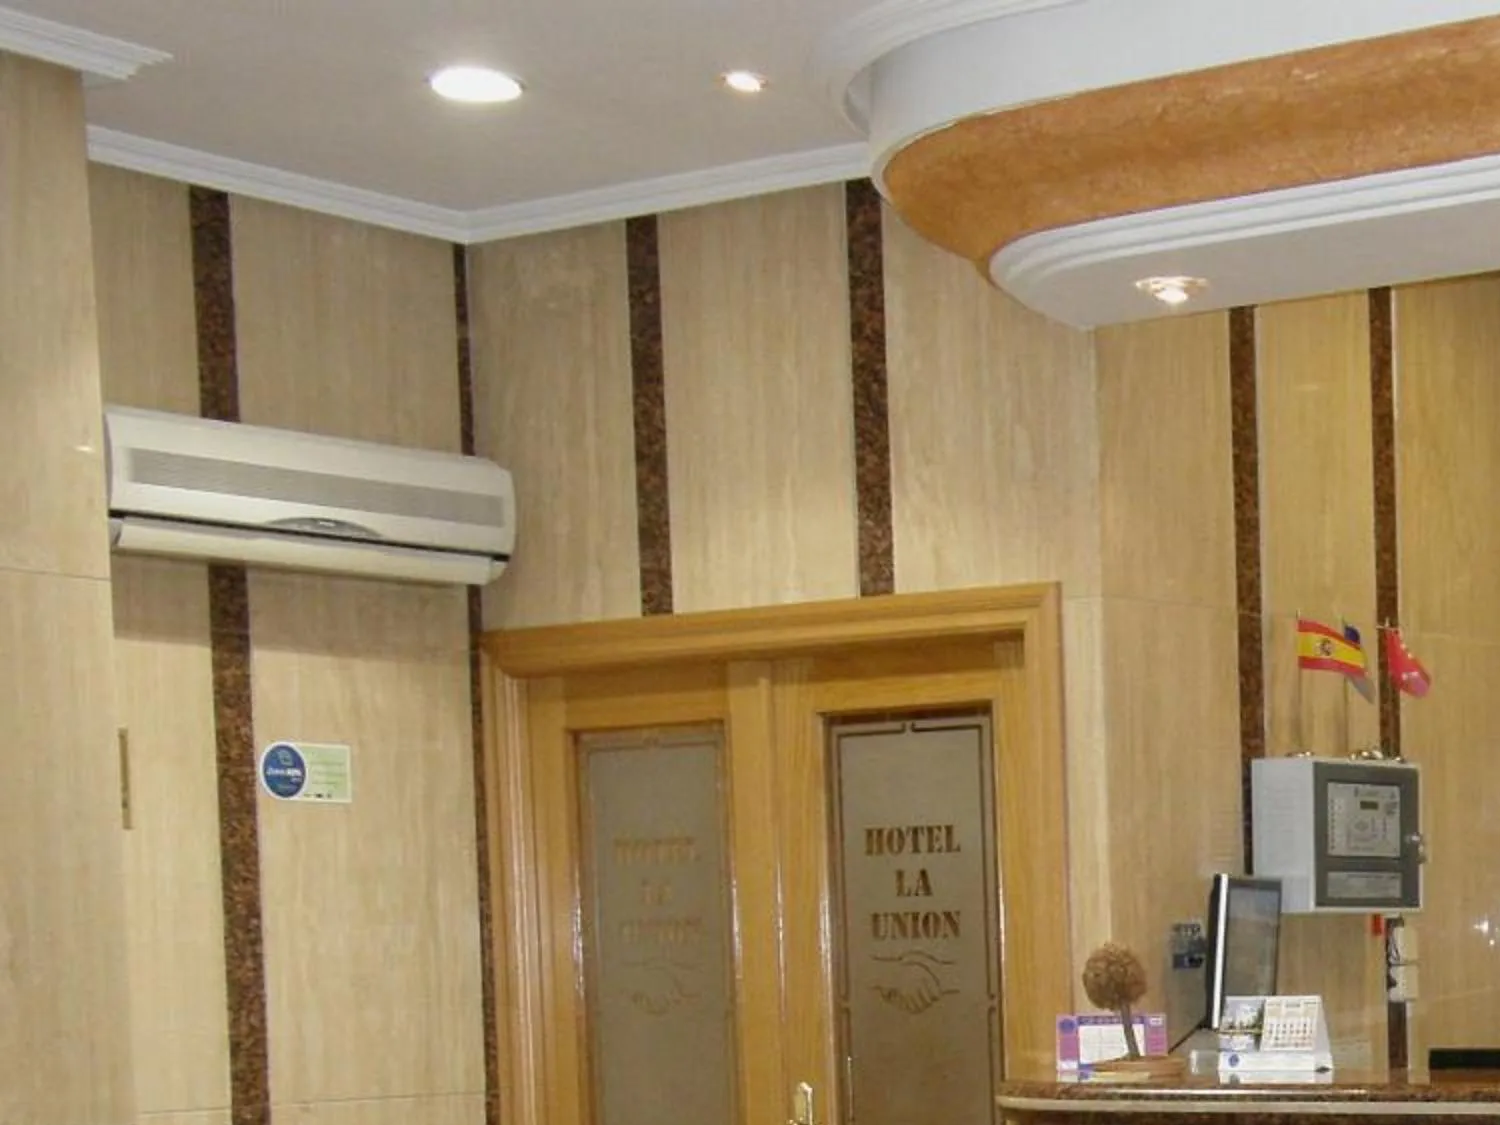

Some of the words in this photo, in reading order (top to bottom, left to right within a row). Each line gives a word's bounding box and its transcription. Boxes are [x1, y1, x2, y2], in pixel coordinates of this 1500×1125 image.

[864, 824, 962, 857] HOTEL
[895, 868, 933, 897] LA
[871, 910, 962, 941] UNION
